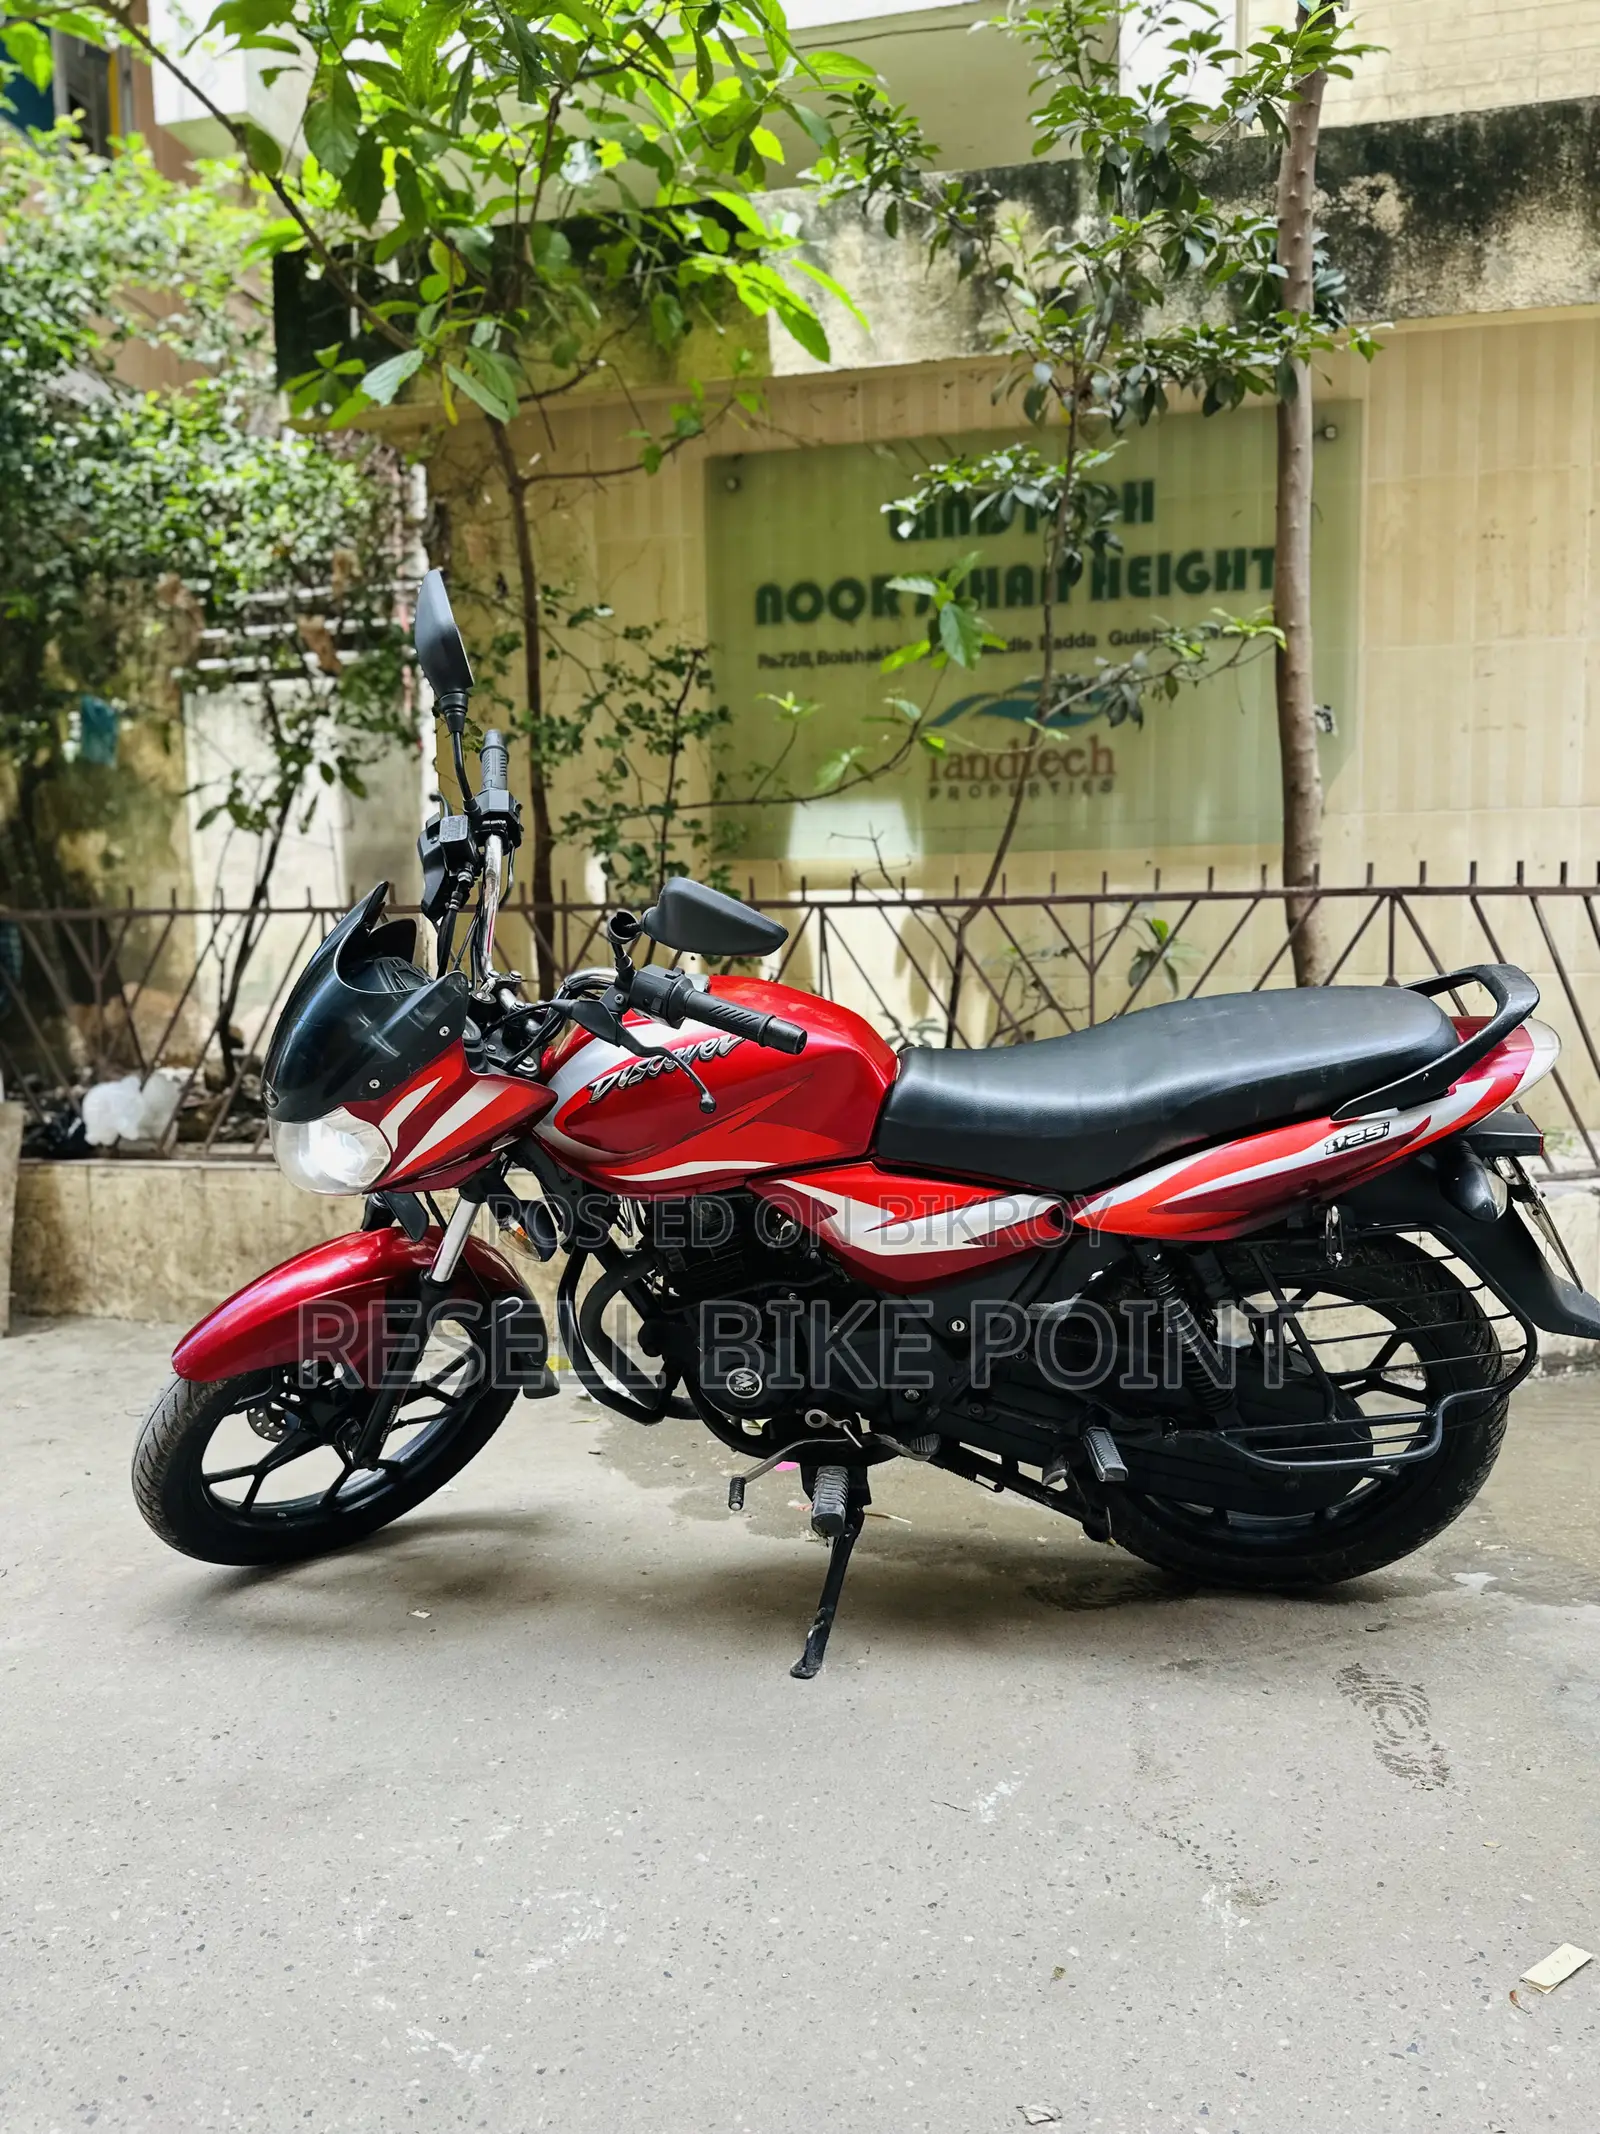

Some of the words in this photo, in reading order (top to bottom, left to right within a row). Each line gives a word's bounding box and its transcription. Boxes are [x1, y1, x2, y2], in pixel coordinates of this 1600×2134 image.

[756, 575, 901, 625] NOOR
[1091, 547, 1275, 600] HEIGHT
[587, 1034, 745, 1104] Discover
